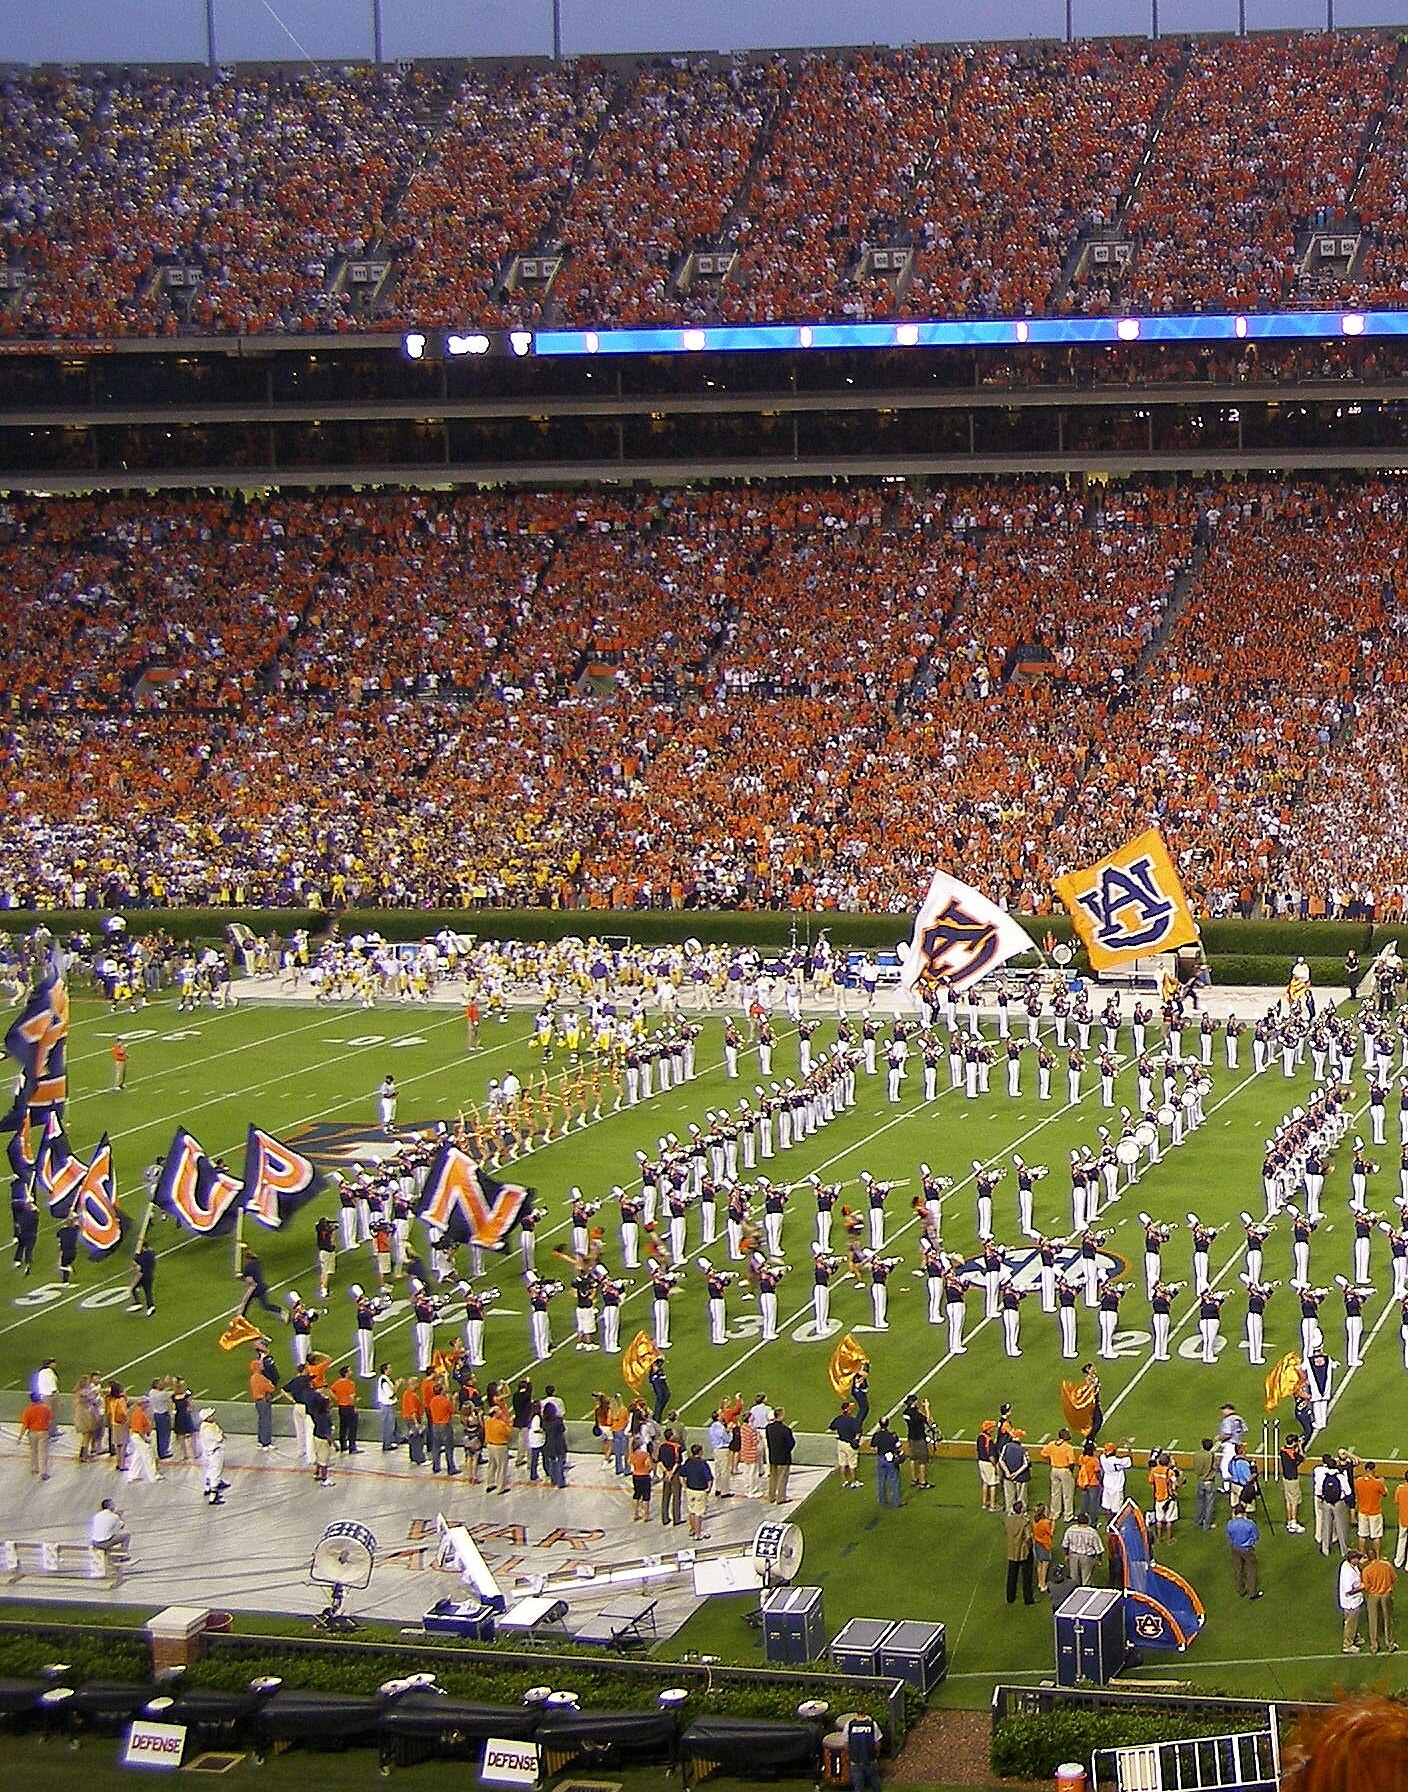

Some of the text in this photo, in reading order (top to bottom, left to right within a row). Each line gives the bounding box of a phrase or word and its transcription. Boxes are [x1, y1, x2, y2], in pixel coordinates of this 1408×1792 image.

[420, 1146, 528, 1249] N
[131, 1732, 182, 1755] DEFENSE
[487, 1751, 539, 1773] DEFENSE
